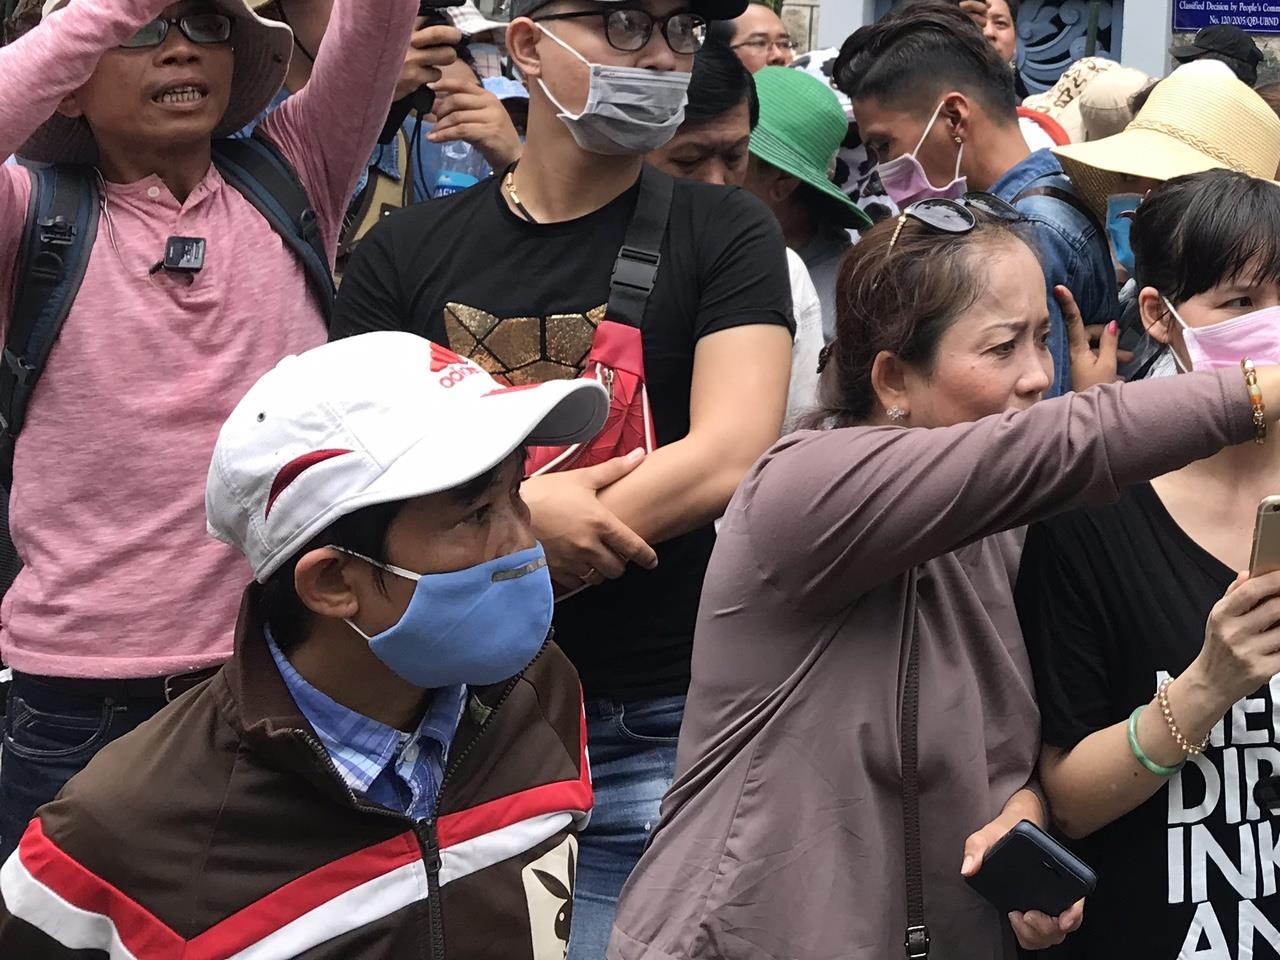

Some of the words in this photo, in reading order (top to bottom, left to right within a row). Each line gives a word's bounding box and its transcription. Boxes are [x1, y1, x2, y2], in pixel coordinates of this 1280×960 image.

[1179, 0, 1205, 10] Classified
[1206, 1, 1229, 11] Decision
[1230, 2, 1238, 13] by
[1239, 2, 1261, 14] People's
